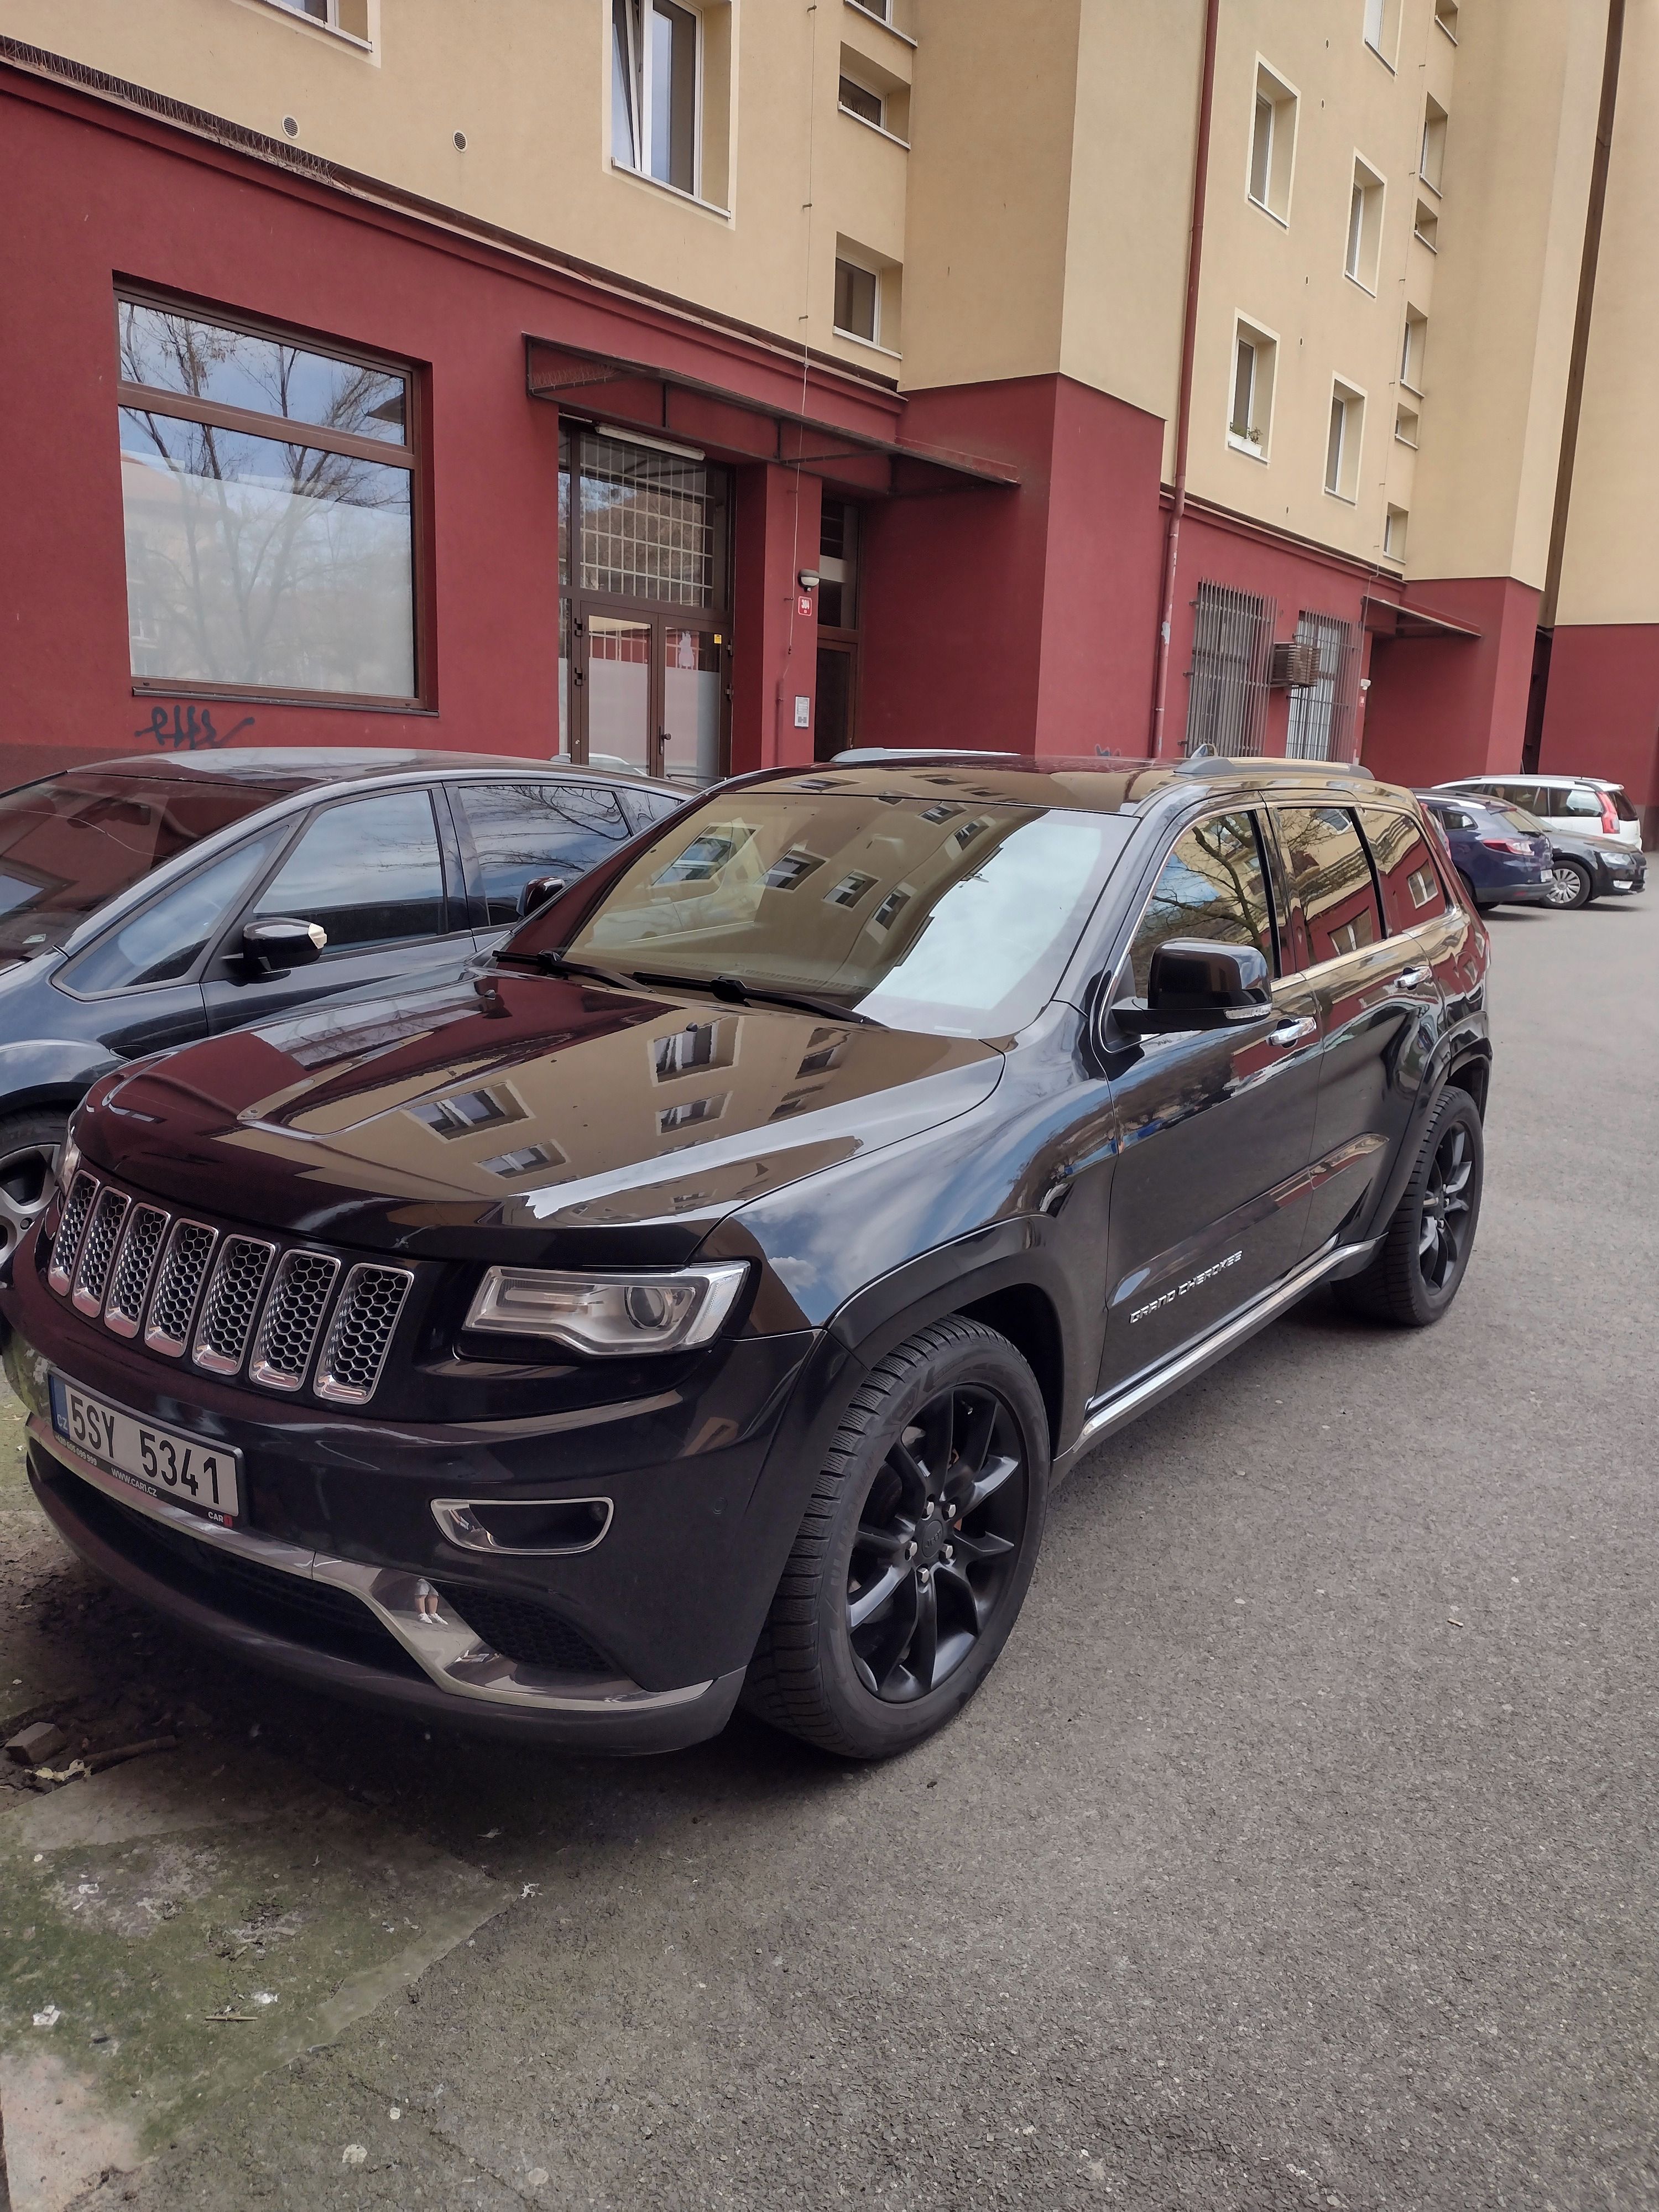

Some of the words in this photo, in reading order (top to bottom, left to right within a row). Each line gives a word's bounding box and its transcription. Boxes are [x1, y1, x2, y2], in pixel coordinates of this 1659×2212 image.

[1130, 1289, 1176, 1323] GRAND
[1178, 1250, 1243, 1296] CHEROKEE
[57, 1413, 68, 1431] CZ
[70, 1393, 114, 1459] 5SY
[139, 1428, 220, 1505] 5341
